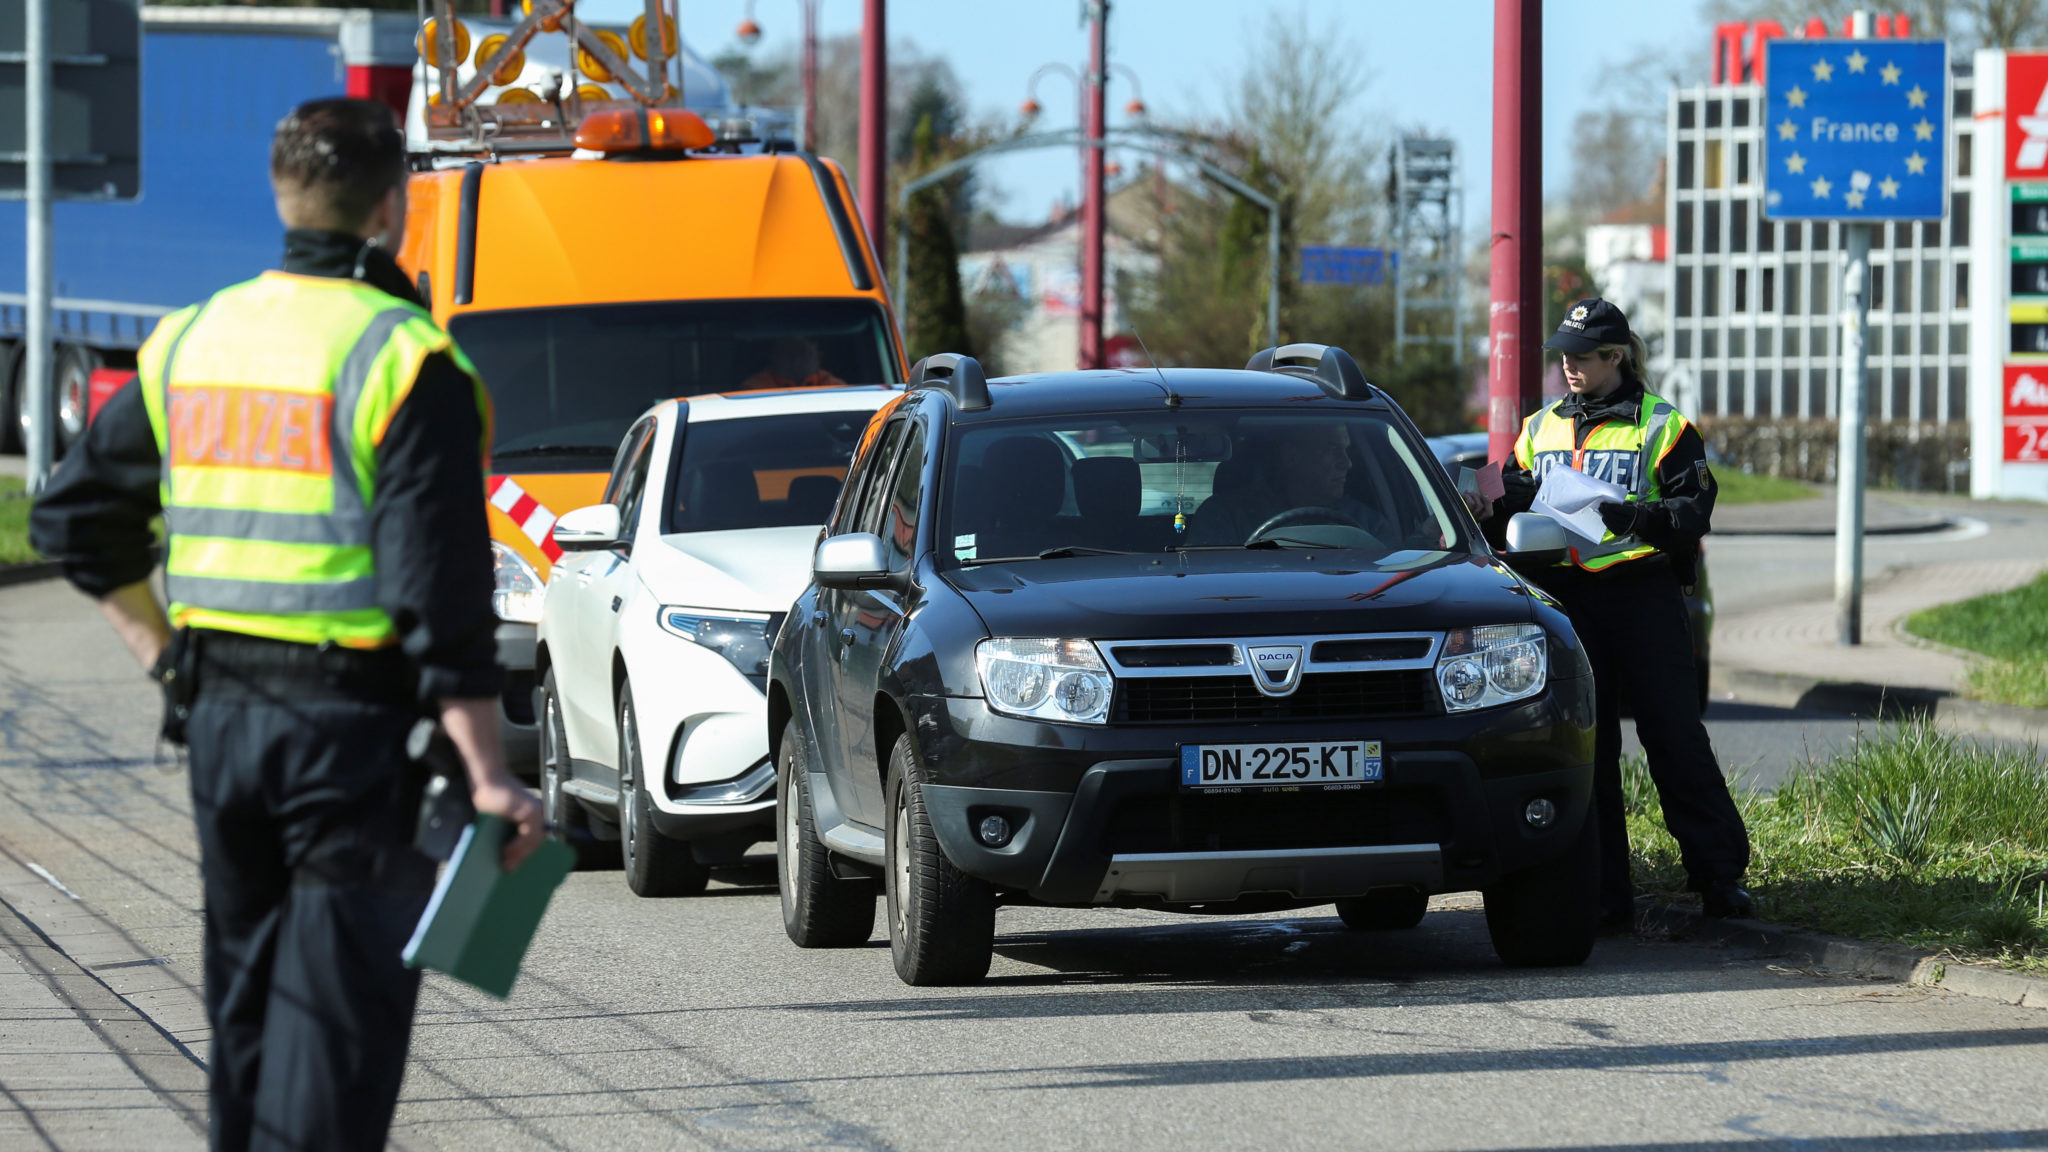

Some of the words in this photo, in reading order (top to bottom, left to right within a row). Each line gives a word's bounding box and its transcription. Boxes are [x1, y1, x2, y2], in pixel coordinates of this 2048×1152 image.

[1812, 116, 1899, 142] France
[1563, 319, 1586, 330] POLIZEI
[167, 390, 324, 468] POLIZEI
[1258, 653, 1294, 661] DACIA
[1187, 769, 1195, 779] F
[1202, 745, 1359, 781] DN-225-KT
[1365, 762, 1381, 777] 57
